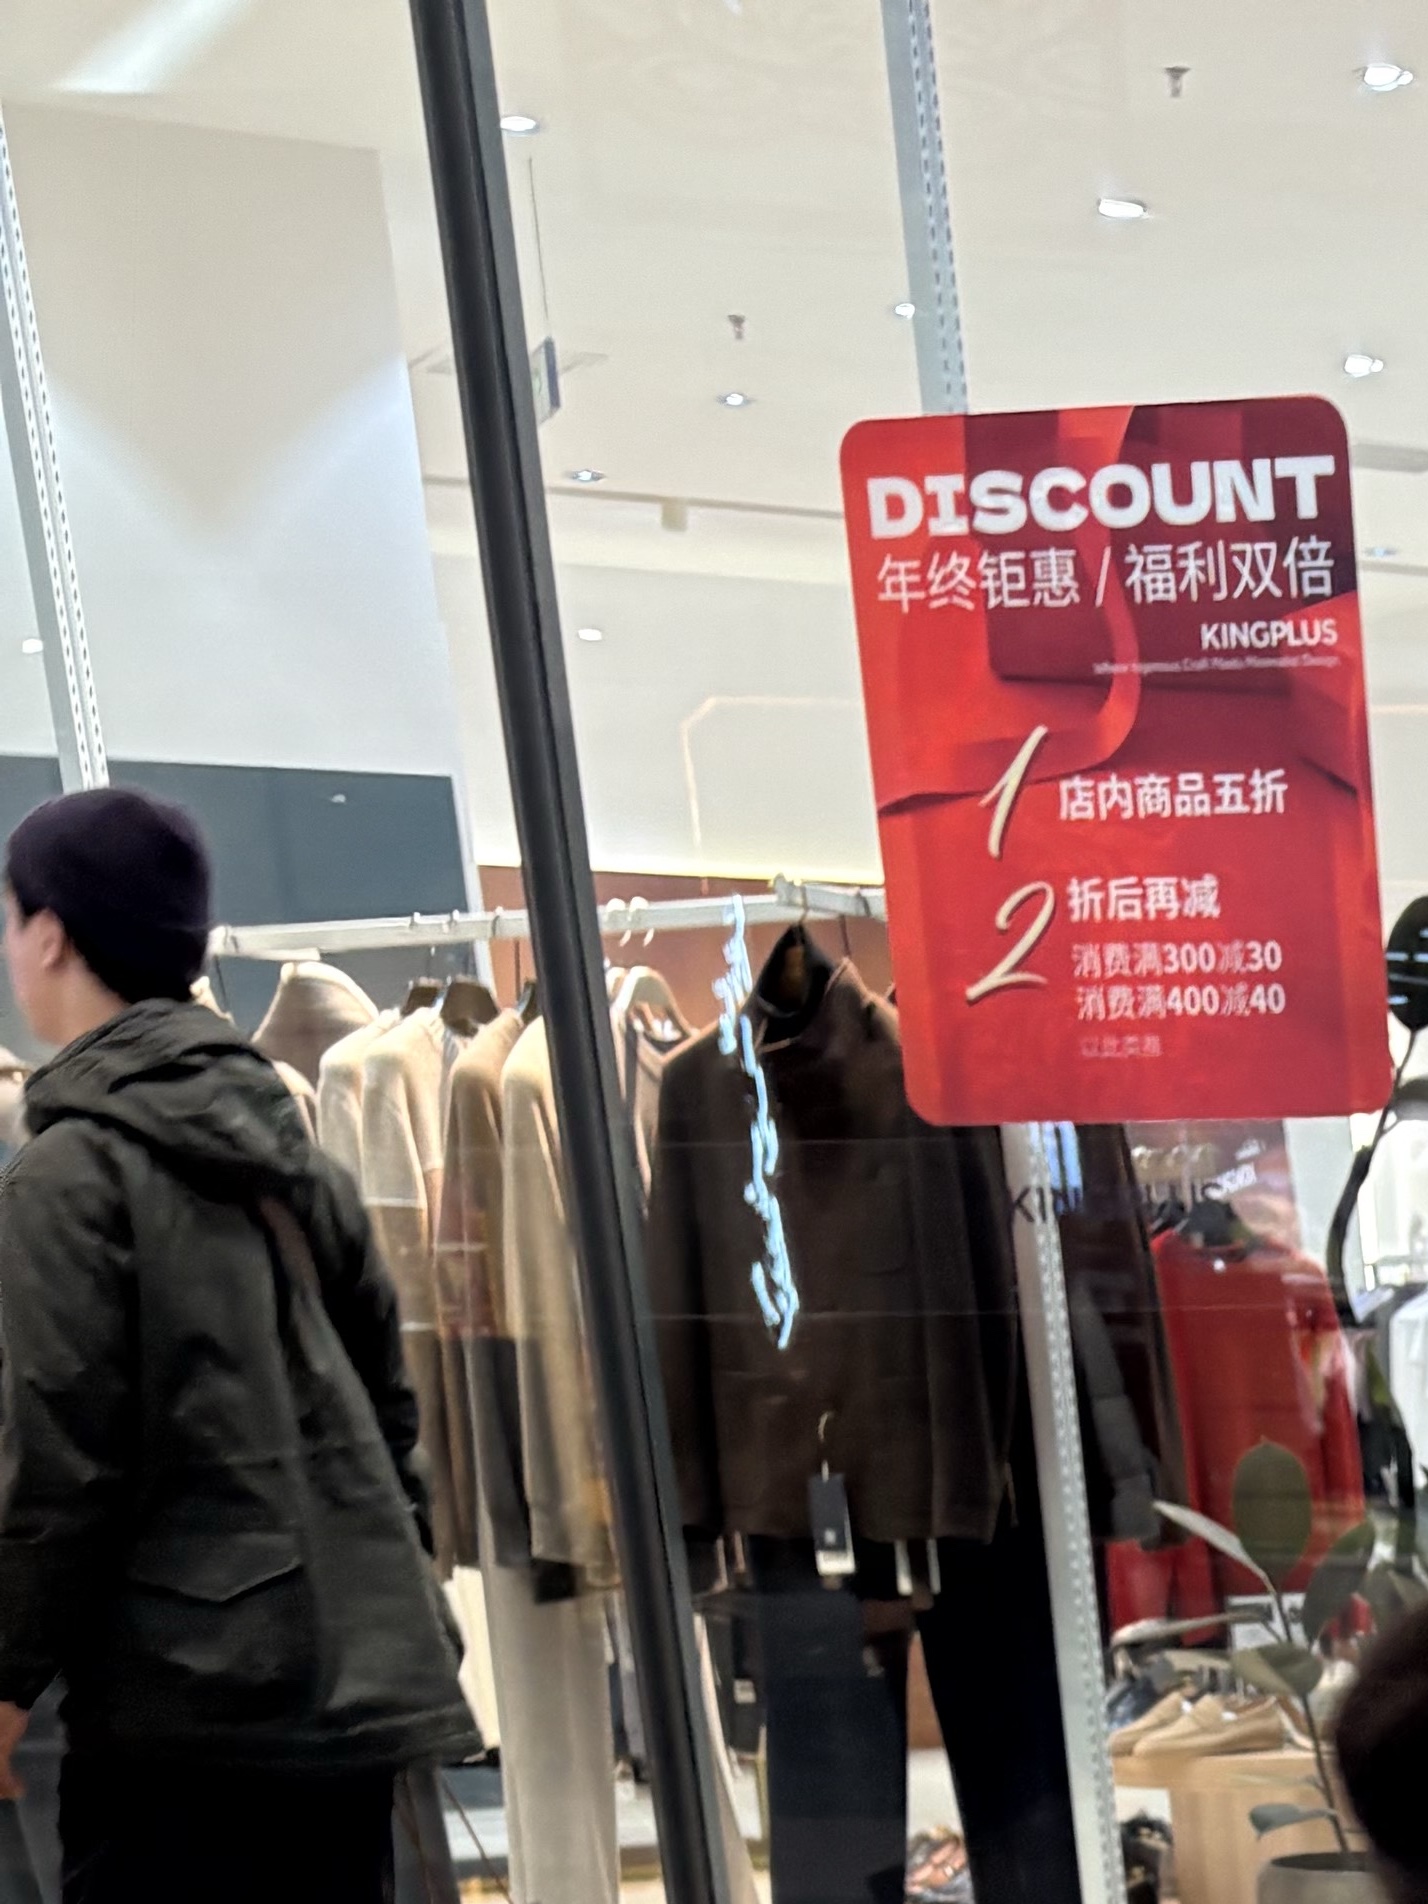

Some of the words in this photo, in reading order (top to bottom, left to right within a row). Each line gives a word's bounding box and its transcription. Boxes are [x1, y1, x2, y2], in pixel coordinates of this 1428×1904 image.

[866, 454, 1336, 539] DISCOUNT
[877, 547, 1080, 614] 年终钜惠
[1125, 535, 1335, 604] 福利双倍
[1200, 618, 1338, 650] KINGPLUS
[978, 724, 1048, 860] 1
[1059, 768, 1288, 822] 店内商品五折
[1067, 873, 1221, 923] 折后再减
[965, 880, 1055, 1002] 2
[1072, 940, 1283, 979] 消费满300减30
[1076, 981, 1286, 1021] 消费满400减40
